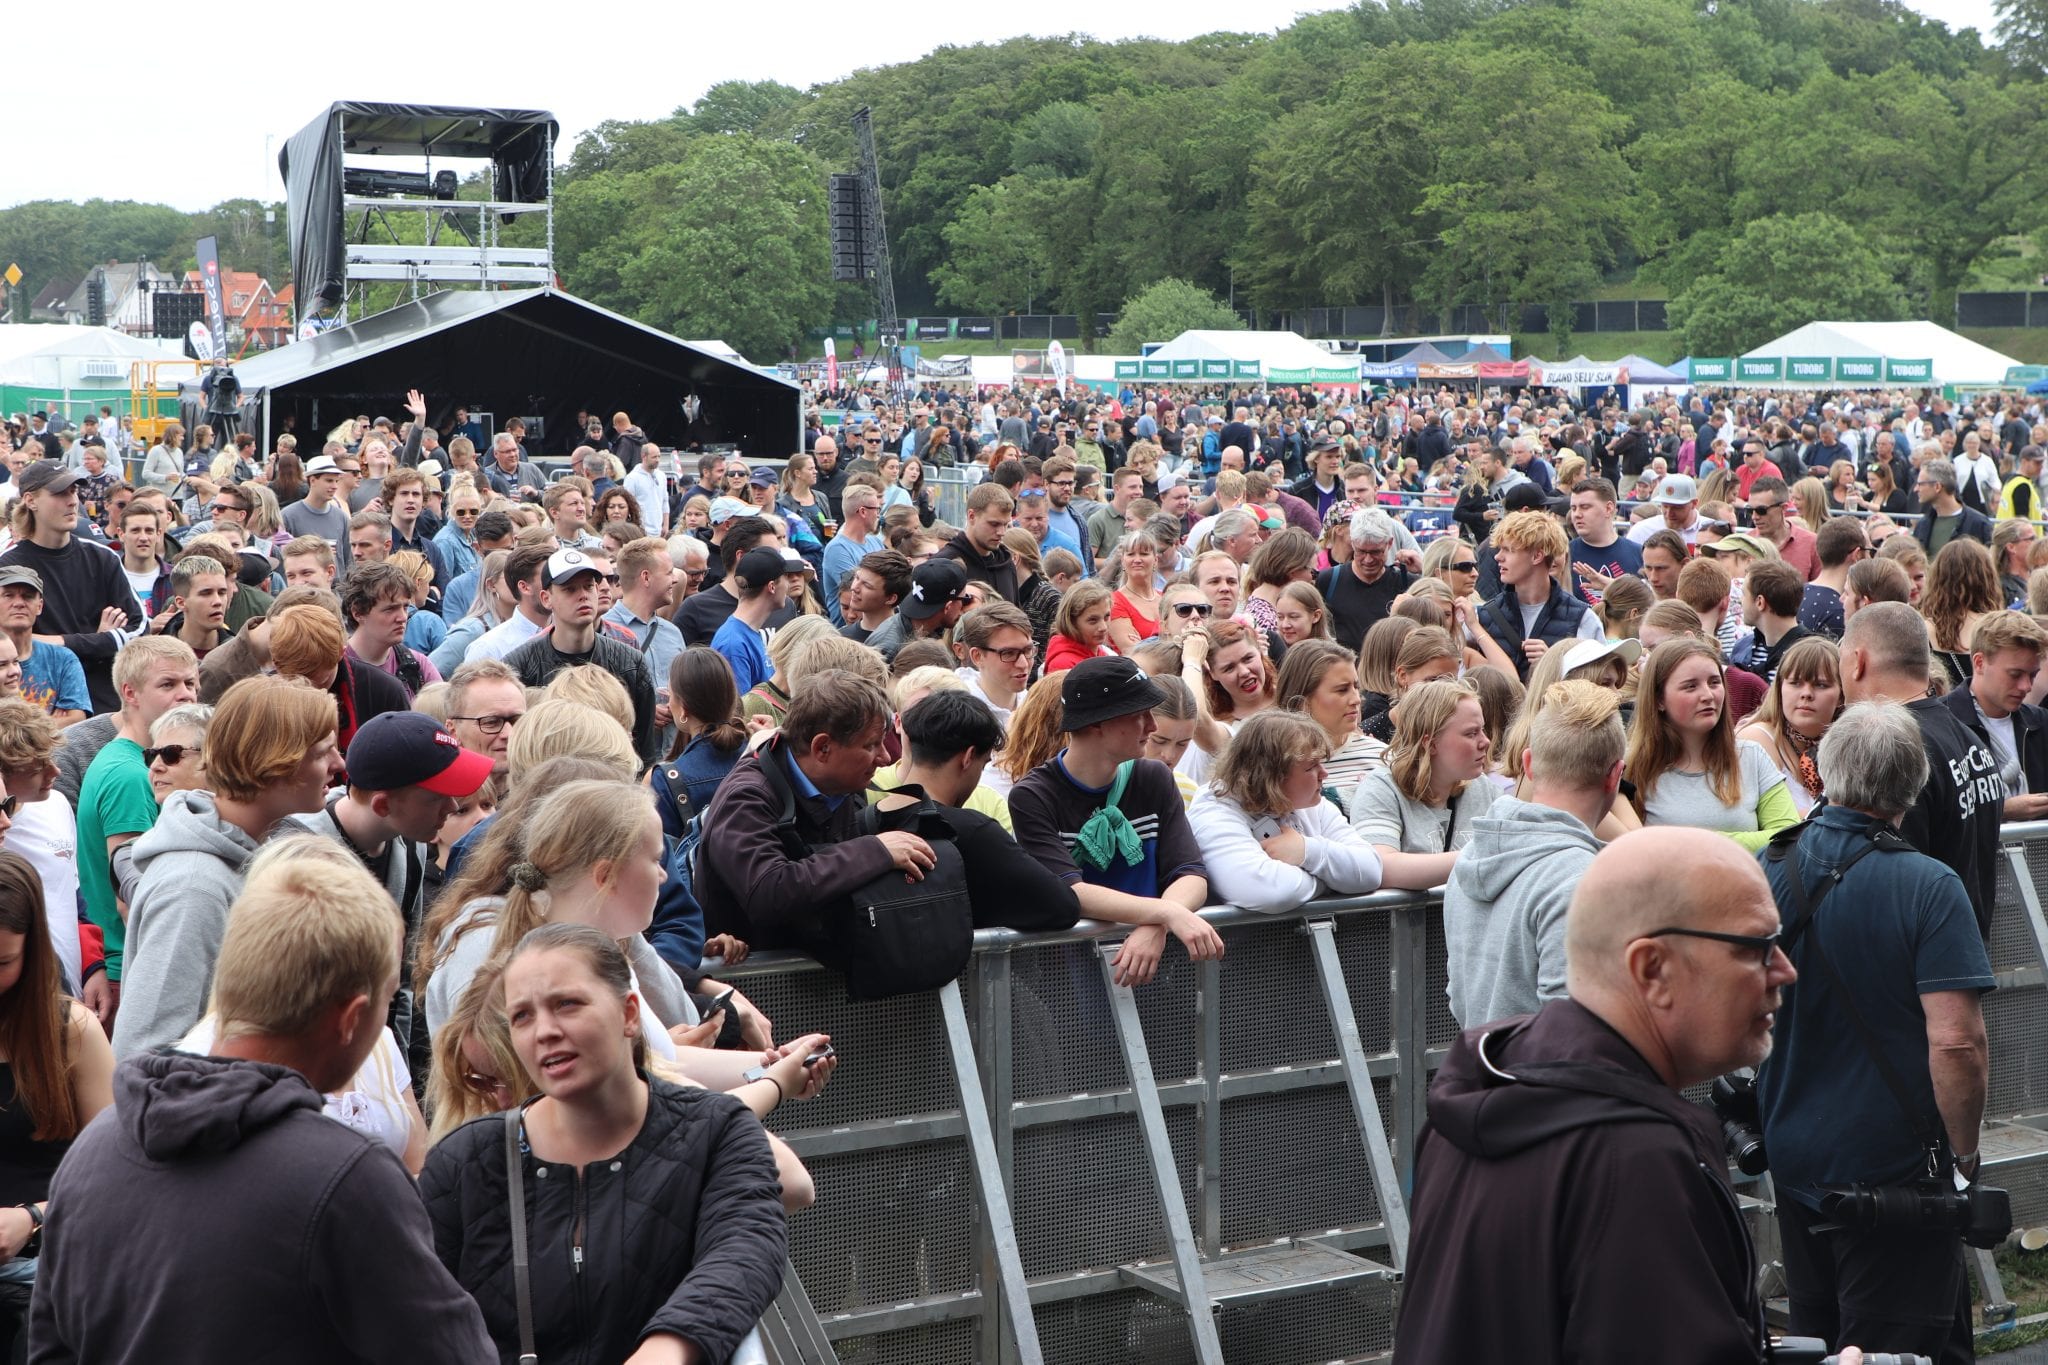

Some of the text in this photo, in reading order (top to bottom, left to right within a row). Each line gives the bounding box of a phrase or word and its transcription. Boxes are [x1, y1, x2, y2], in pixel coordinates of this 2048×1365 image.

[1695, 364, 1725, 376] TUBORG
[1743, 363, 1775, 375] TUBORG
[1792, 363, 1825, 375] TUBORG
[1842, 363, 1874, 375] TUBORG
[1891, 364, 1926, 377] TUBORG
[1546, 372, 1572, 383] BLAND
[1574, 371, 1594, 383] SELV
